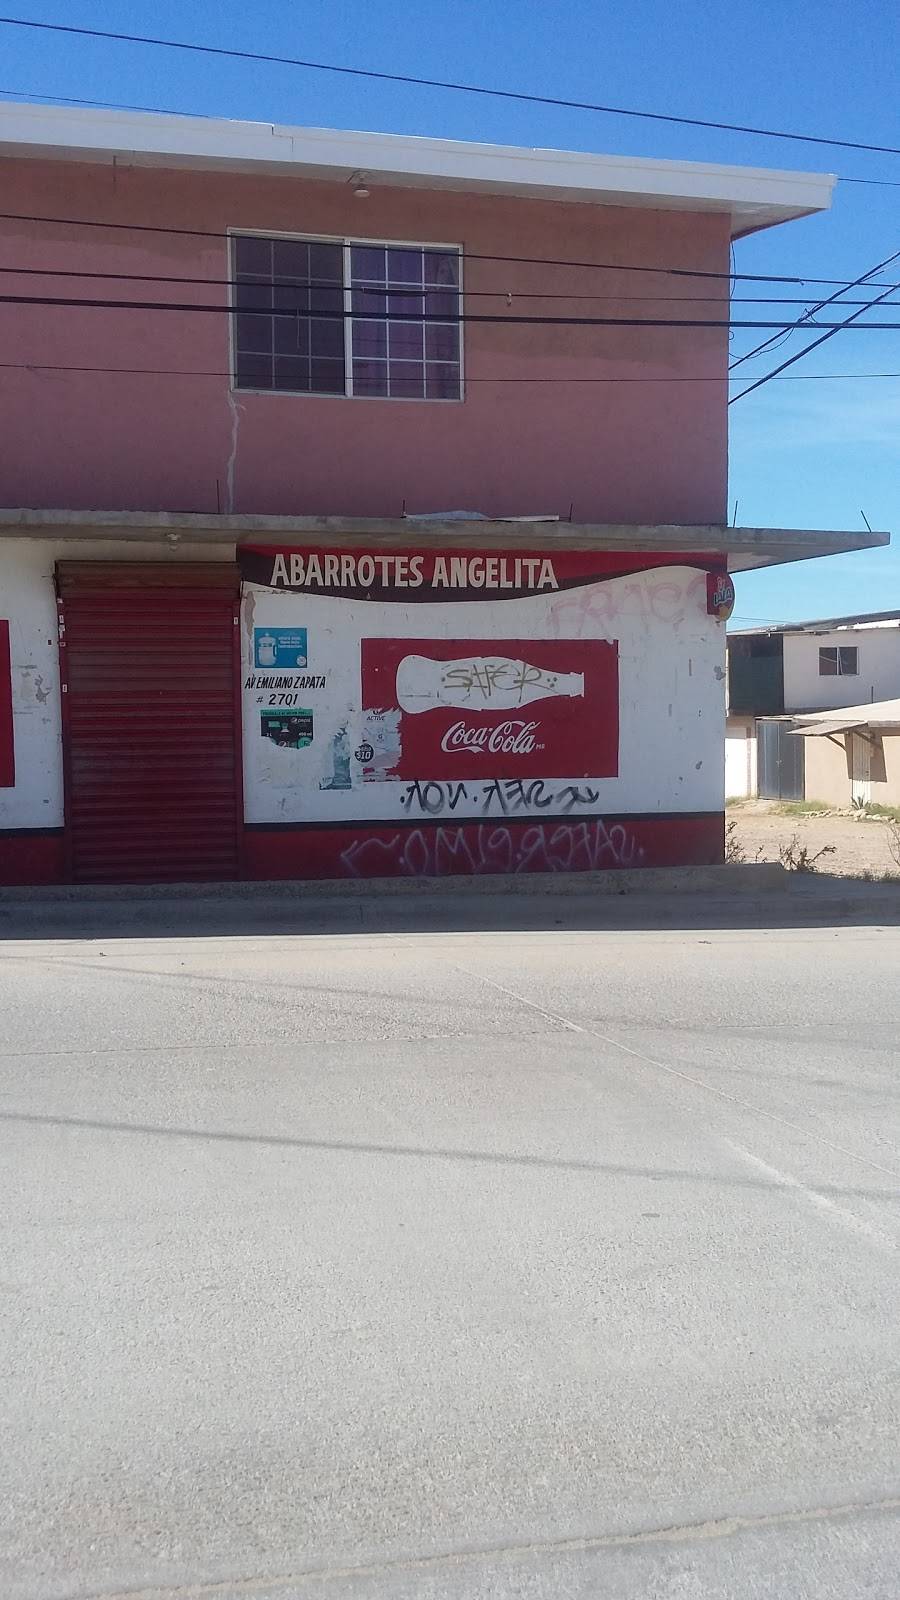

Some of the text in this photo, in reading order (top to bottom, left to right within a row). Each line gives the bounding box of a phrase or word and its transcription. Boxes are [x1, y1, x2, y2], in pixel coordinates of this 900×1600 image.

[270, 553, 559, 589] ABARROTES ANGELITA
[256, 676, 293, 689] EMILIANO
[293, 676, 326, 689] ZAPATA
[441, 720, 542, 754] Coca-Cola
